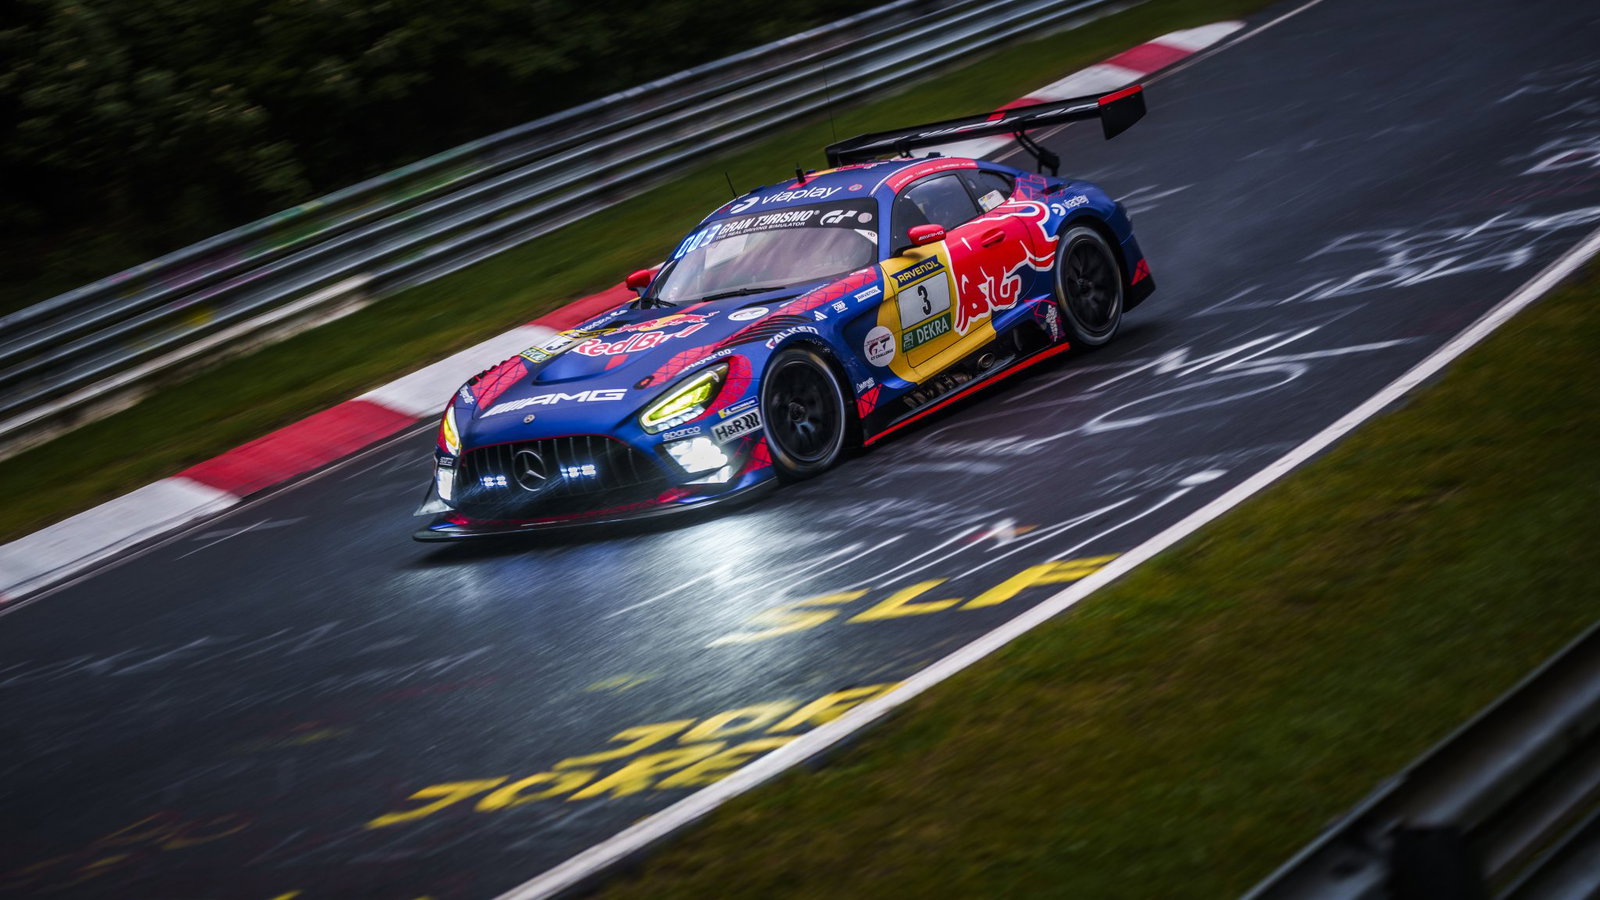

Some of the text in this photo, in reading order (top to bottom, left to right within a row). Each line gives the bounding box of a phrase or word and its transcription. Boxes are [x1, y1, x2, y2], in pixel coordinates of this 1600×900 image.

[762, 186, 843, 205] viaplay
[718, 217, 756, 236] GRAN
[768, 221, 806, 230] SIMULATOR
[897, 260, 939, 284] RAVENOL
[917, 285, 932, 316] 3
[765, 325, 819, 350] FALKEN
[916, 317, 949, 345] DEKRA
[571, 331, 645, 357] Red
[663, 426, 701, 440] sparco
[715, 419, 744, 440] H&R
